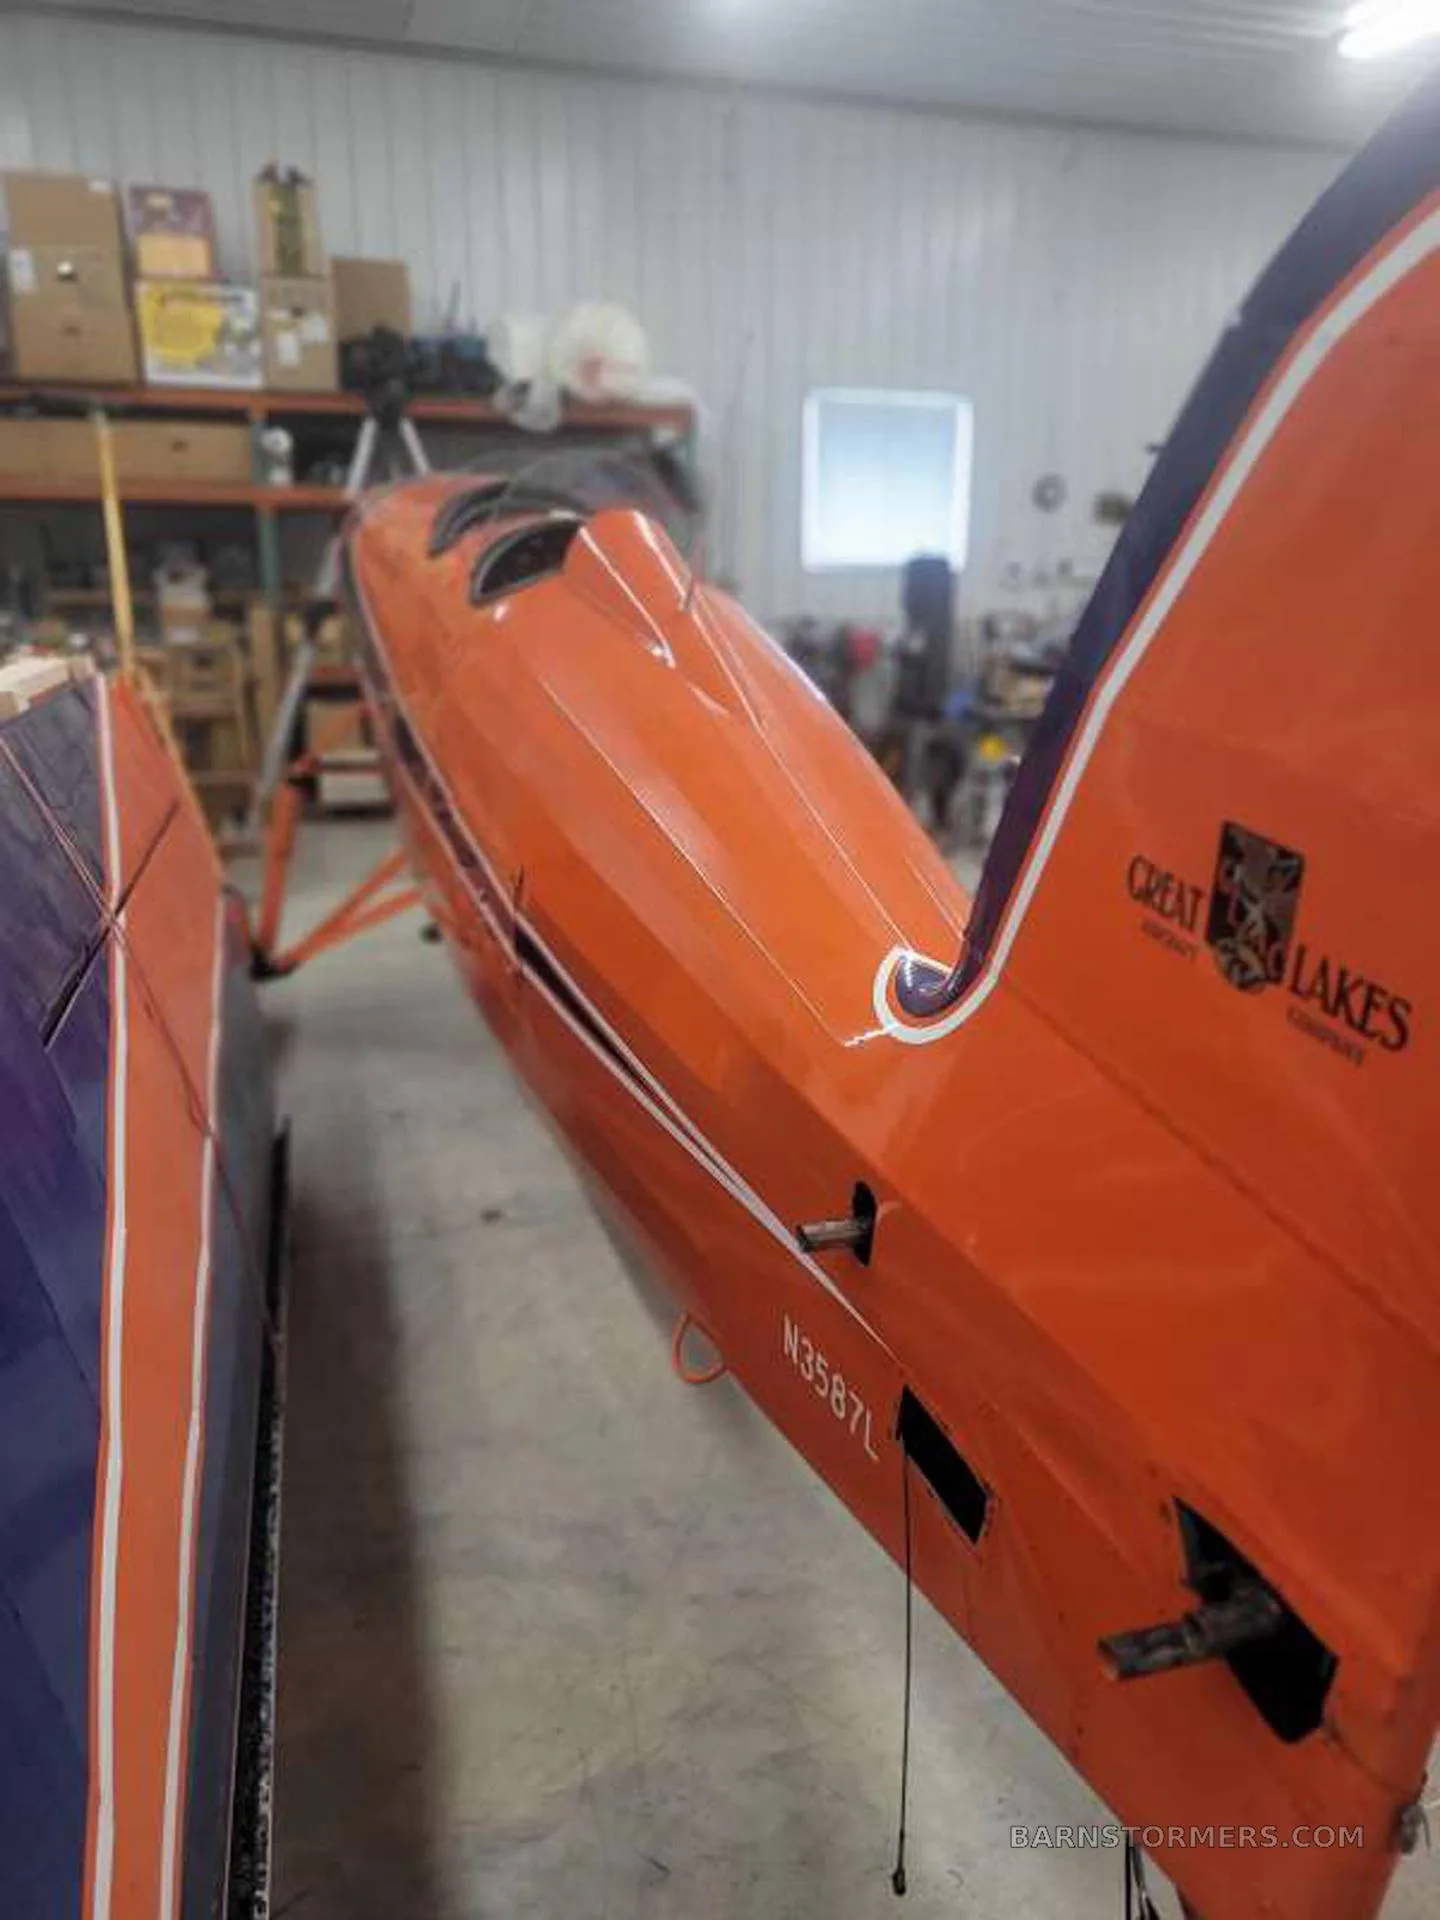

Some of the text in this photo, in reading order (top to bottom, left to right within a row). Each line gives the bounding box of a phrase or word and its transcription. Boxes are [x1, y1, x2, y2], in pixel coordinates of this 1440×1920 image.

[1127, 855, 1205, 932] GREAT
[1290, 944, 1412, 1051] LAKES
[783, 1313, 880, 1462] N3587L
